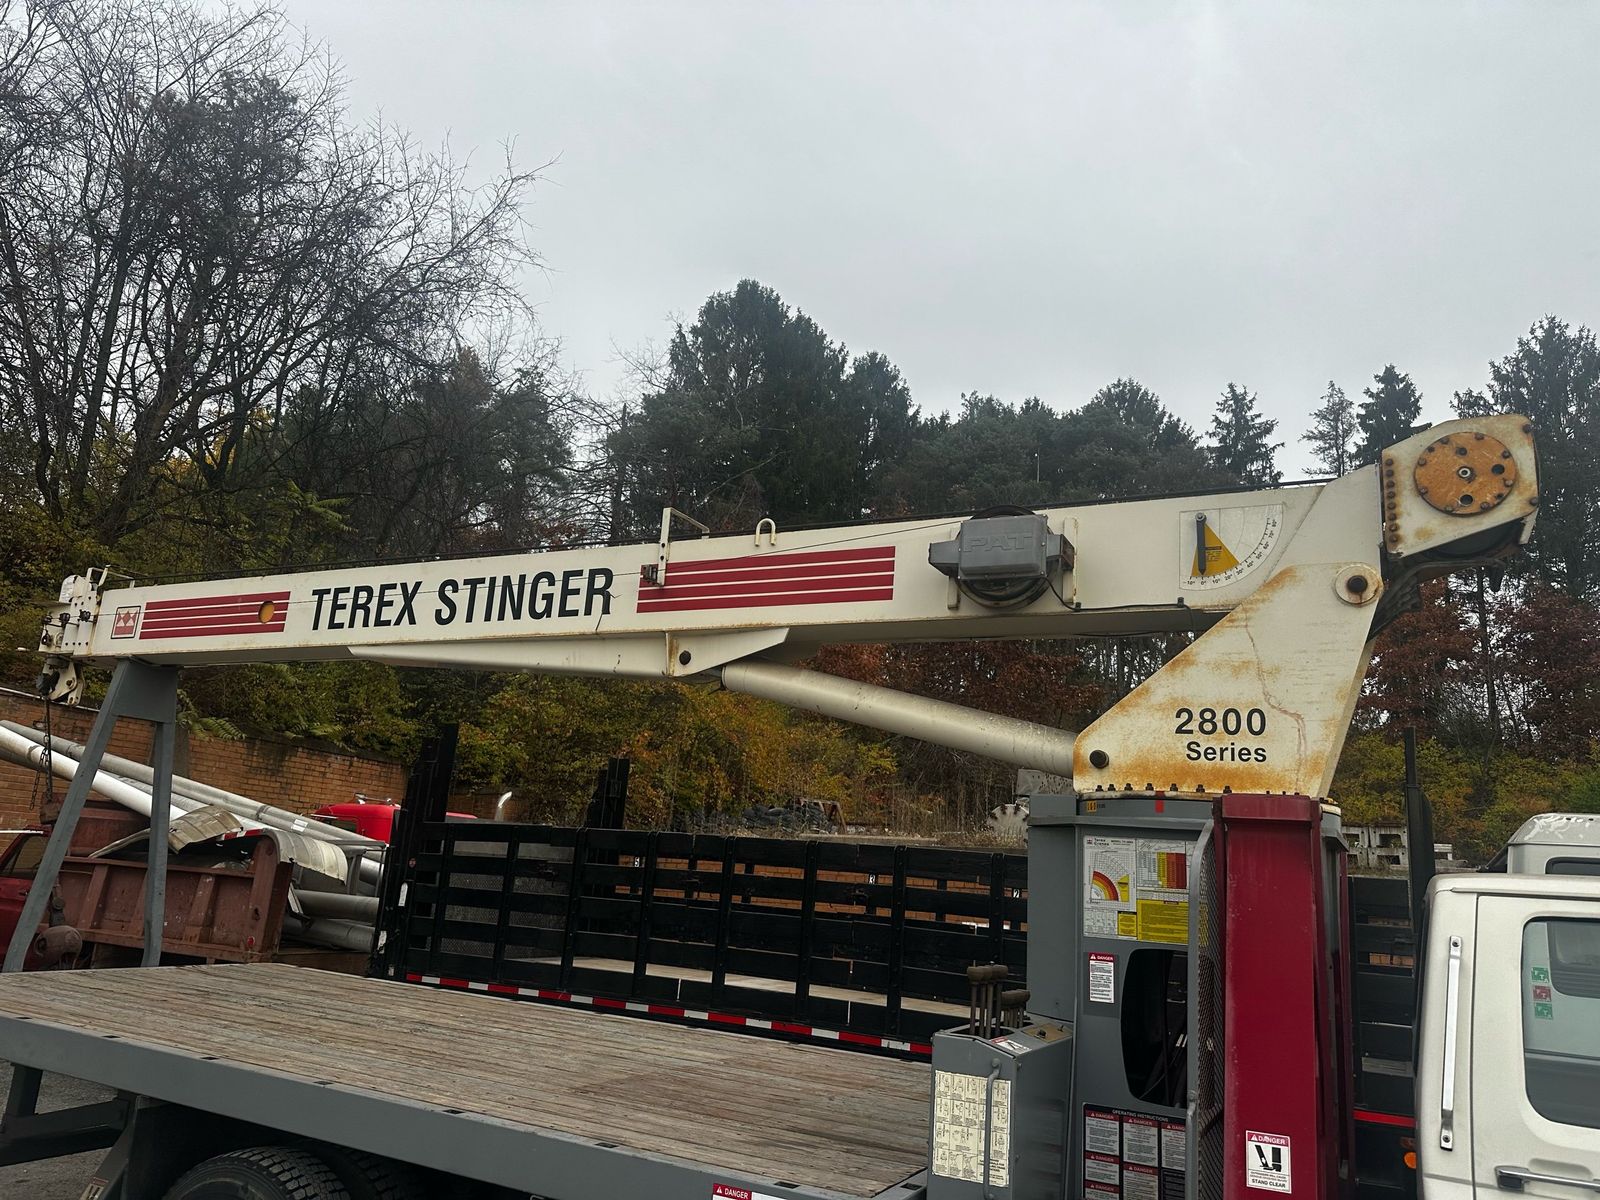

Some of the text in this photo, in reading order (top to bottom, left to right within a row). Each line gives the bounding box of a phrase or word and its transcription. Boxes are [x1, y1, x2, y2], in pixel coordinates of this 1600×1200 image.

[963, 532, 1033, 552] PAT
[311, 567, 614, 631] TEREX STINGER
[1175, 707, 1266, 736] 2800
[1186, 741, 1267, 762] Series
[1112, 1109, 1168, 1122] OPERATING INSTRUCTIONS
[1258, 1135, 1286, 1145] DANGER
[724, 1188, 749, 1200] DANGER
